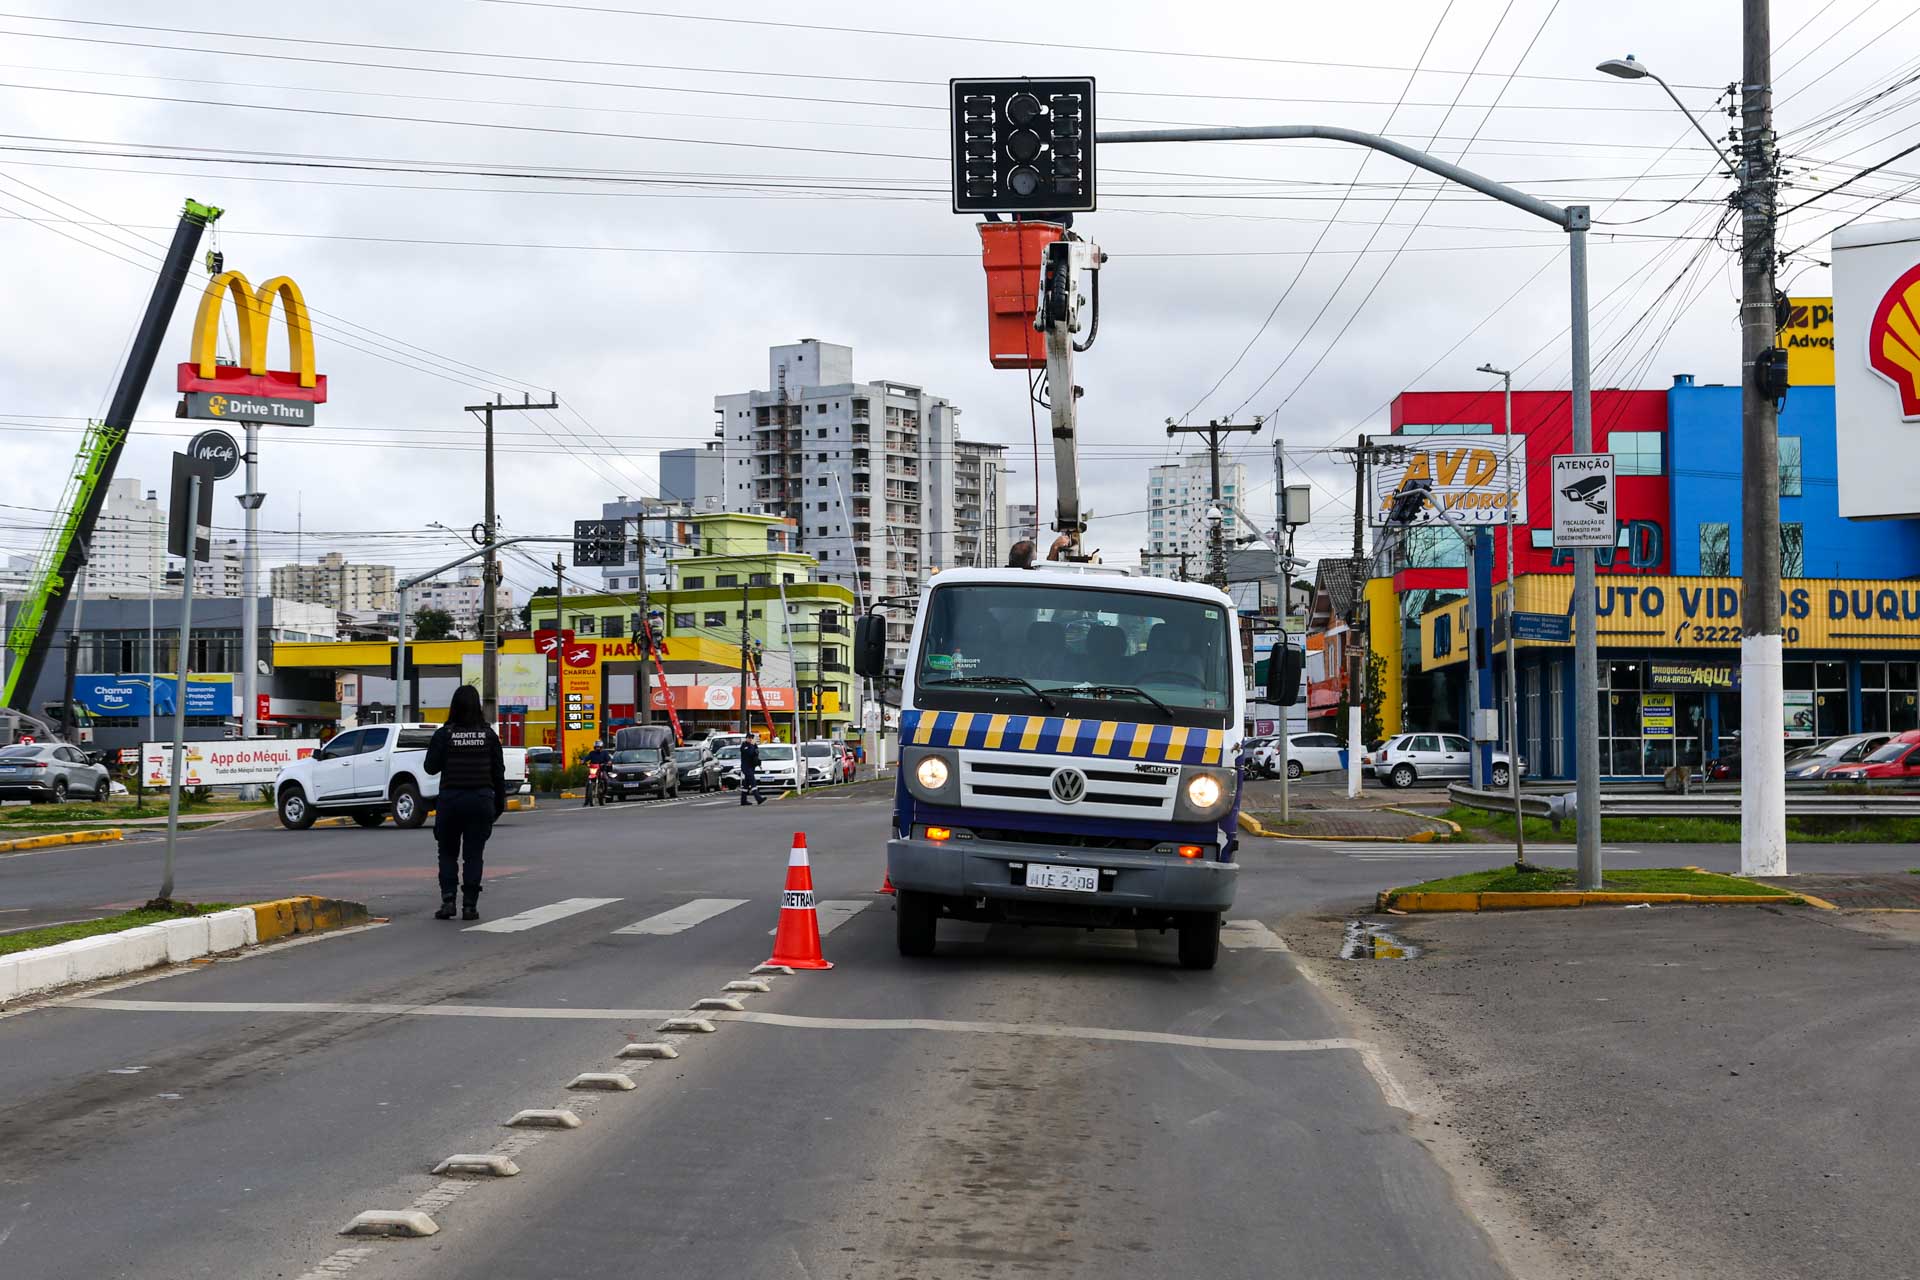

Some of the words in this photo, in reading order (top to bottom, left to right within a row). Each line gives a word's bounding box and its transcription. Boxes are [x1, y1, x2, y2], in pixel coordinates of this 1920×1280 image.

[230, 400, 268, 415] Drive
[270, 403, 304, 418] Thru
[200, 446, 233, 461] McCafé
[1397, 448, 1498, 492] AVD
[1557, 458, 1610, 471] ATENÇÃO
[1443, 492, 1519, 511] VIDROS
[1567, 585, 1665, 618] UTO
[1679, 587, 1810, 619] VIDS
[603, 643, 670, 657] HARA
[563, 668, 596, 676] CHARRUA
[94, 686, 133, 695] Charrua
[104, 695, 124, 703] Plus
[210, 752, 234, 766] App
[236, 752, 251, 763] do
[782, 892, 815, 907] RETRAN
